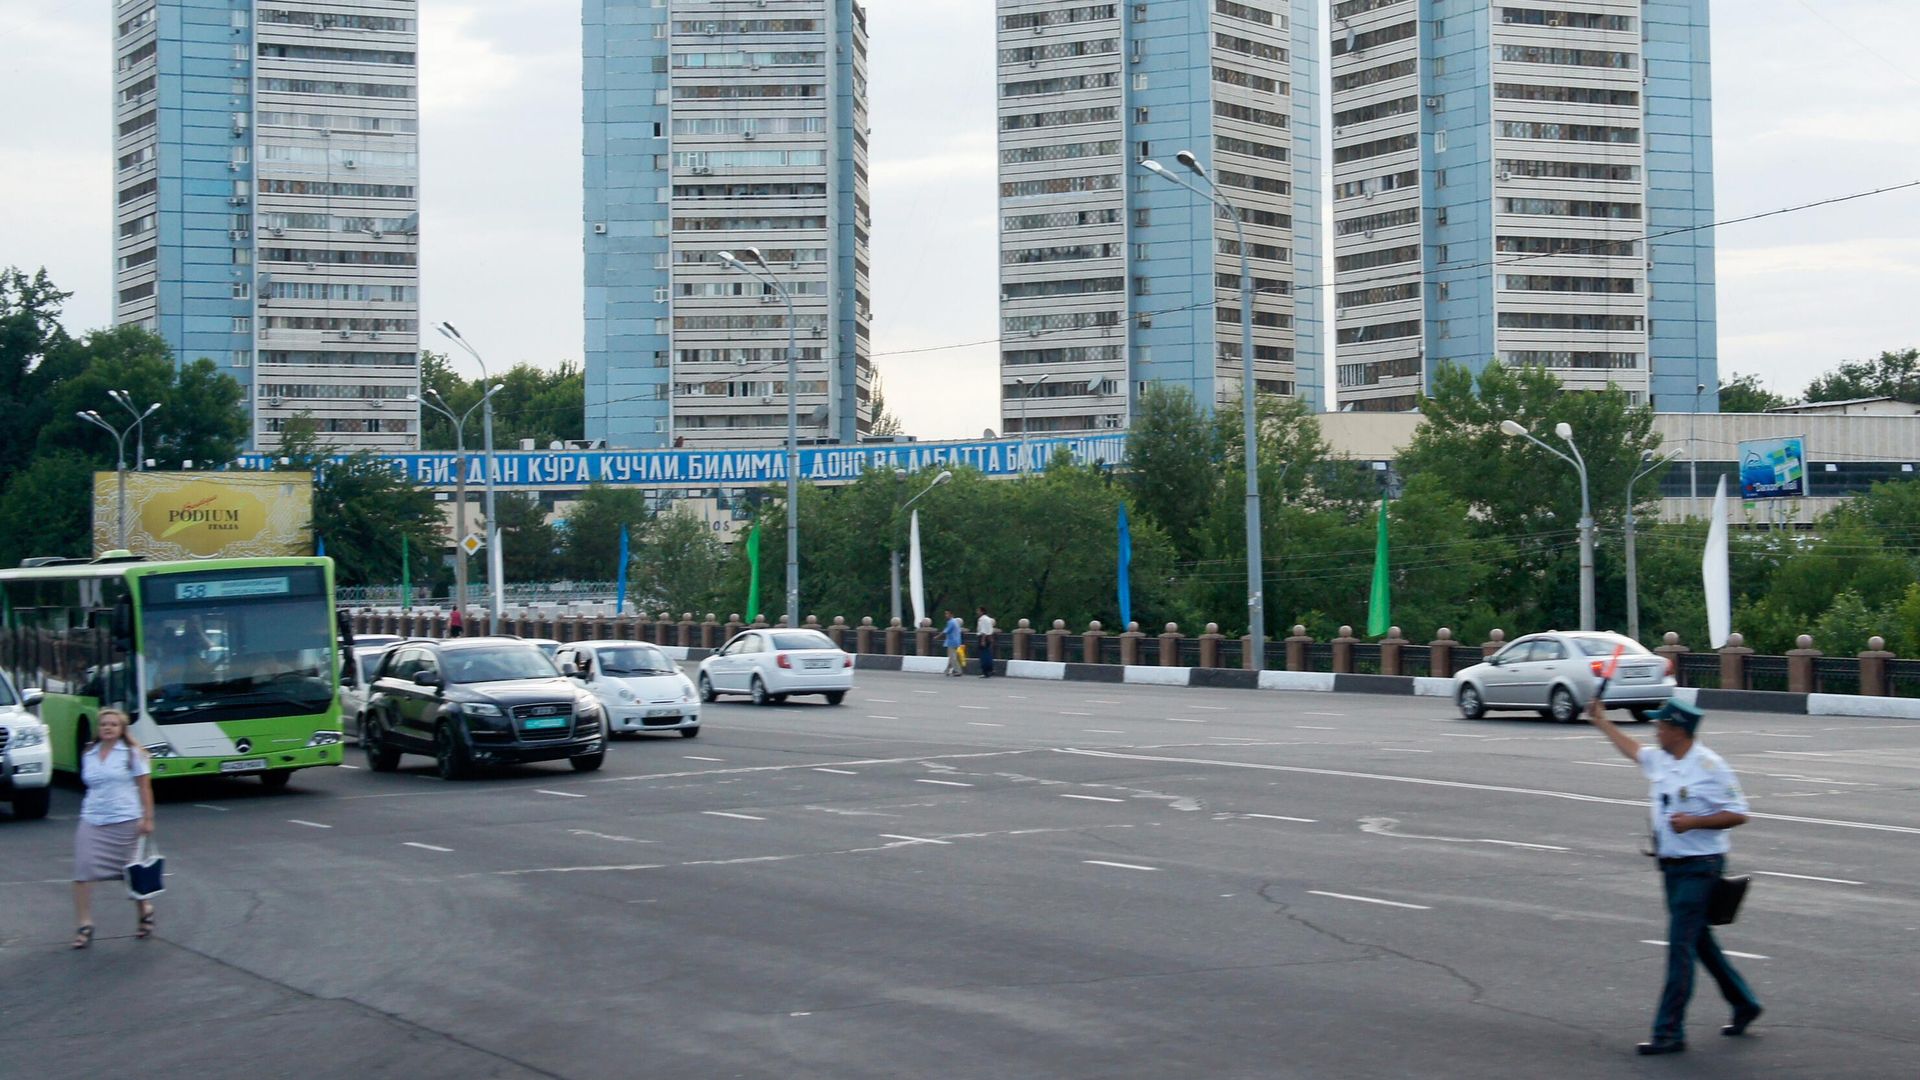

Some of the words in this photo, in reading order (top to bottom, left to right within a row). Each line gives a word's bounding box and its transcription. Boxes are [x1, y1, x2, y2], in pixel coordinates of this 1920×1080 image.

[873, 450, 899, 473] ВА
[1006, 442, 1058, 470] БАХТЛ
[169, 509, 240, 522] PODIUM
[183, 584, 206, 599] 58
